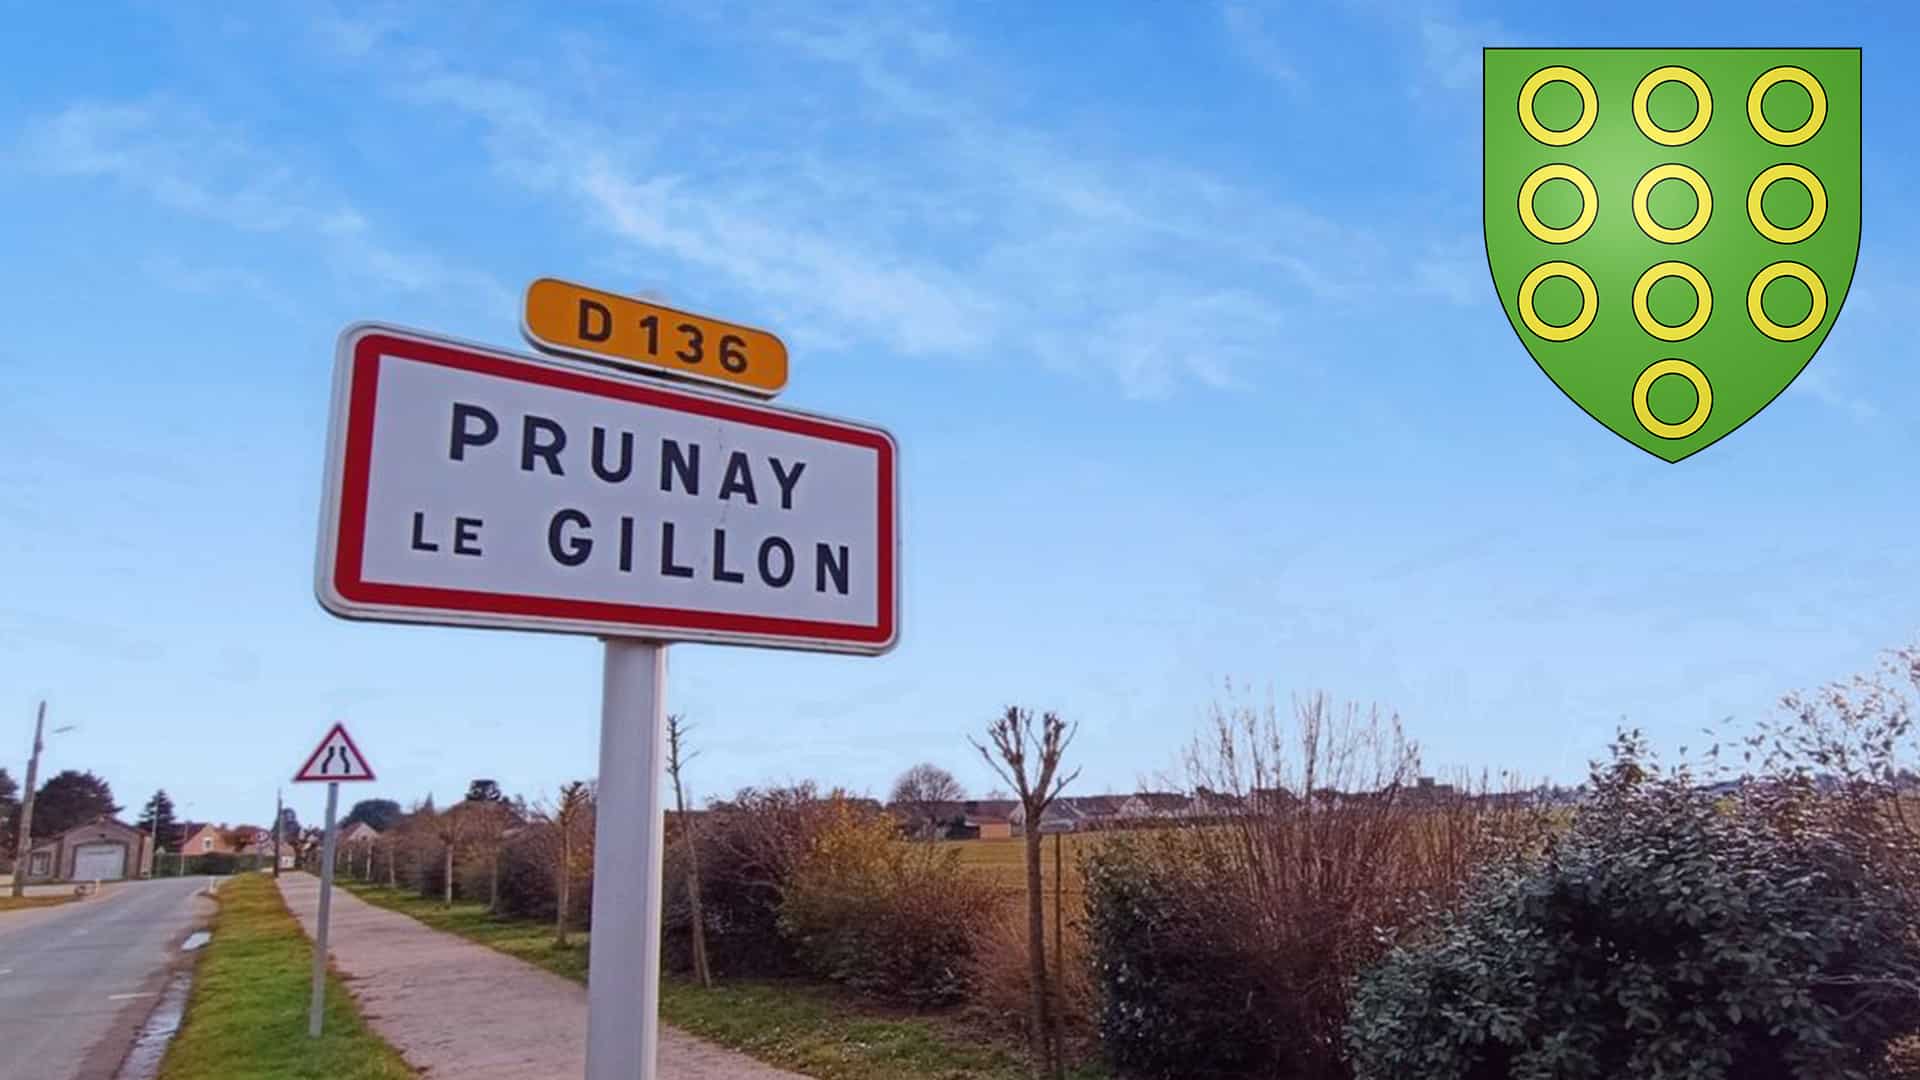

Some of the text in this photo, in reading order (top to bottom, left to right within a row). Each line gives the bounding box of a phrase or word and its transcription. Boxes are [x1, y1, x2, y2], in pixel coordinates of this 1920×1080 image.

[577, 299, 748, 373] D 136
[449, 402, 806, 509] PRUNAY
[411, 509, 849, 595] LE GILLON
